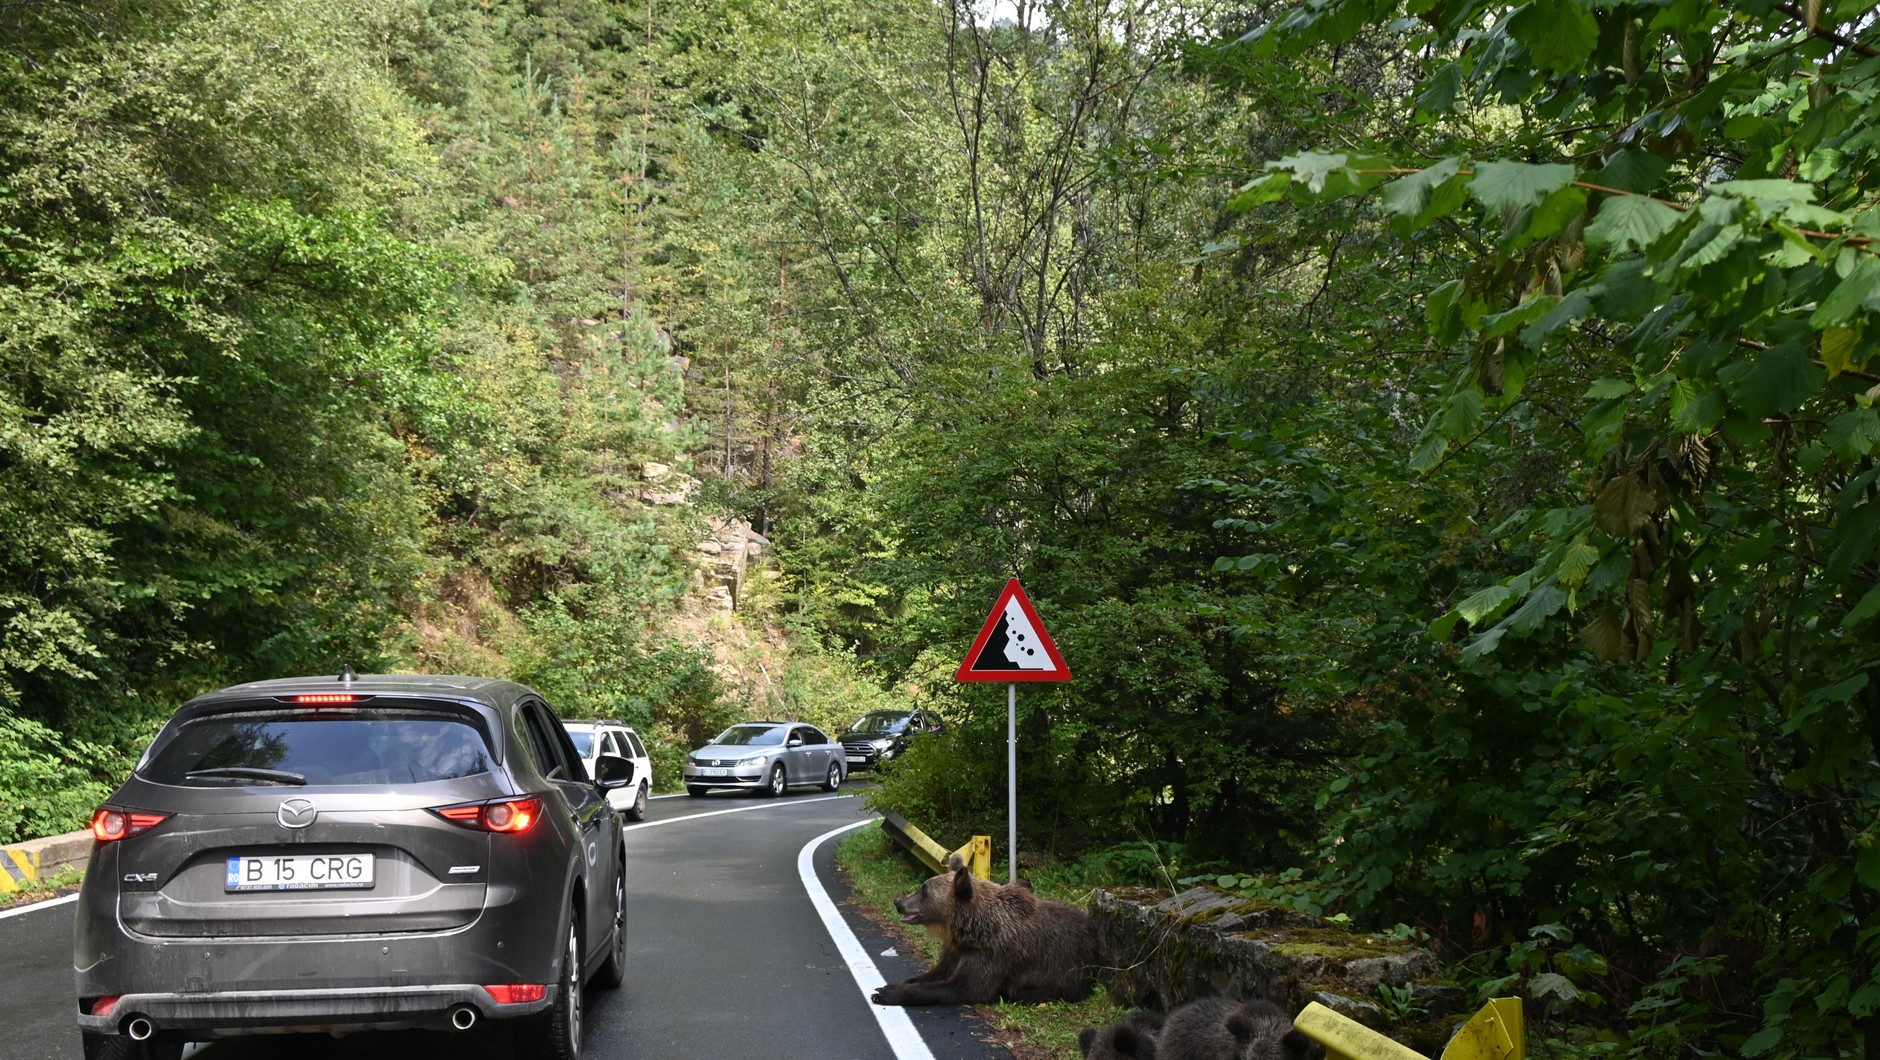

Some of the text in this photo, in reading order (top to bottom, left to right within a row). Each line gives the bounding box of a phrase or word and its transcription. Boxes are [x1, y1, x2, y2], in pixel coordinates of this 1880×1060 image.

[246, 857, 363, 882] B 15 CRG
[124, 873, 158, 882] CX-5
[227, 873, 239, 883] RO
